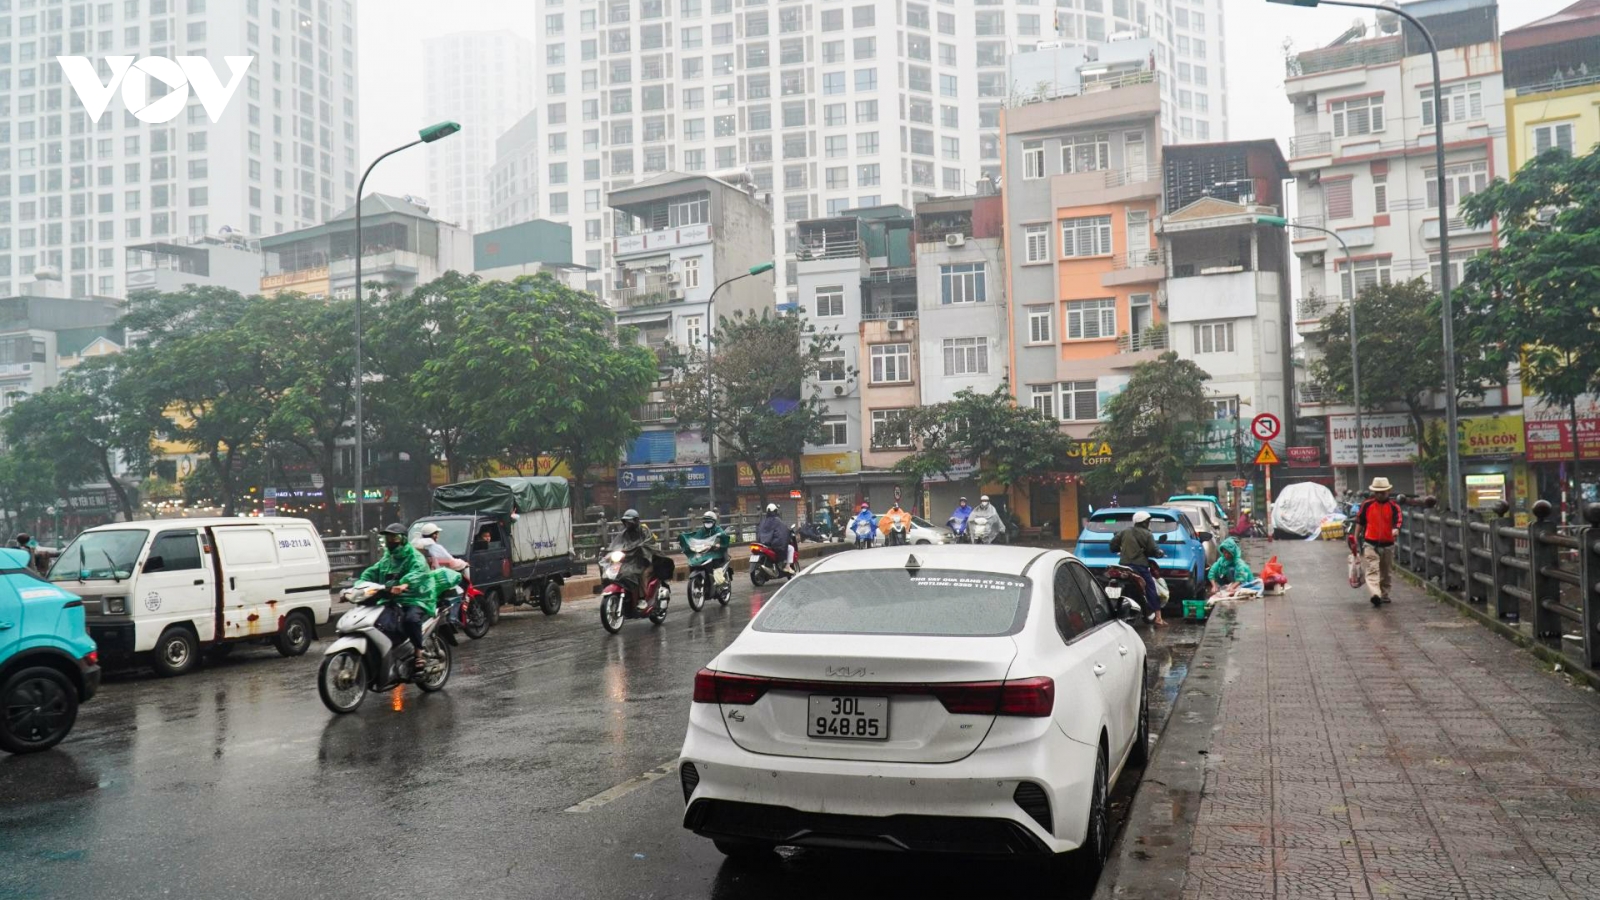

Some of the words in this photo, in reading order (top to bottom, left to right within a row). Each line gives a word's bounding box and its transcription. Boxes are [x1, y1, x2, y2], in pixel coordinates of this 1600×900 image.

[1470, 433, 1490, 446] SÀI
[1492, 431, 1517, 445] GÒN
[831, 697, 865, 716] 30L
[816, 717, 879, 737] 948.85
